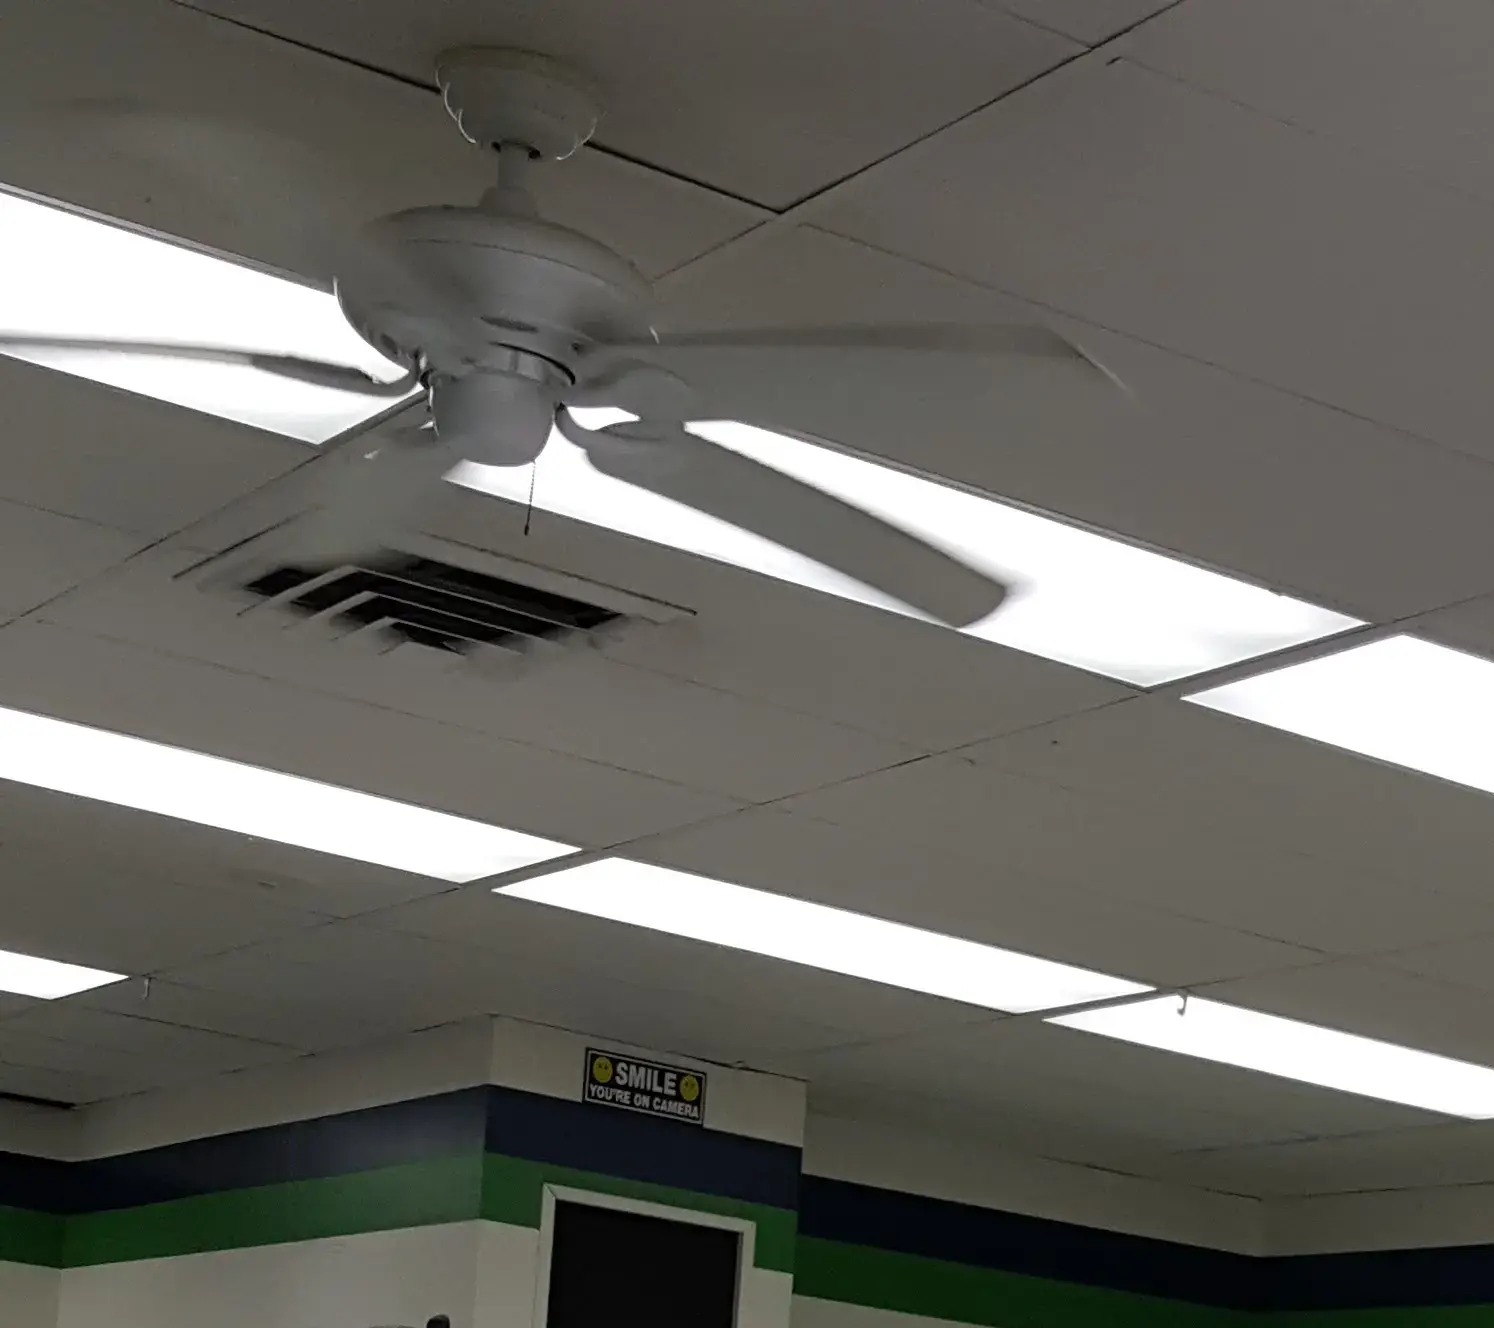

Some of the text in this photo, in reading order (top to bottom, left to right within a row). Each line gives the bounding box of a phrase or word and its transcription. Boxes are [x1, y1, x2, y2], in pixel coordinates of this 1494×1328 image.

[615, 1062, 677, 1096] SMILE
[589, 1083, 699, 1118] YOU'RE ON CAMERA
